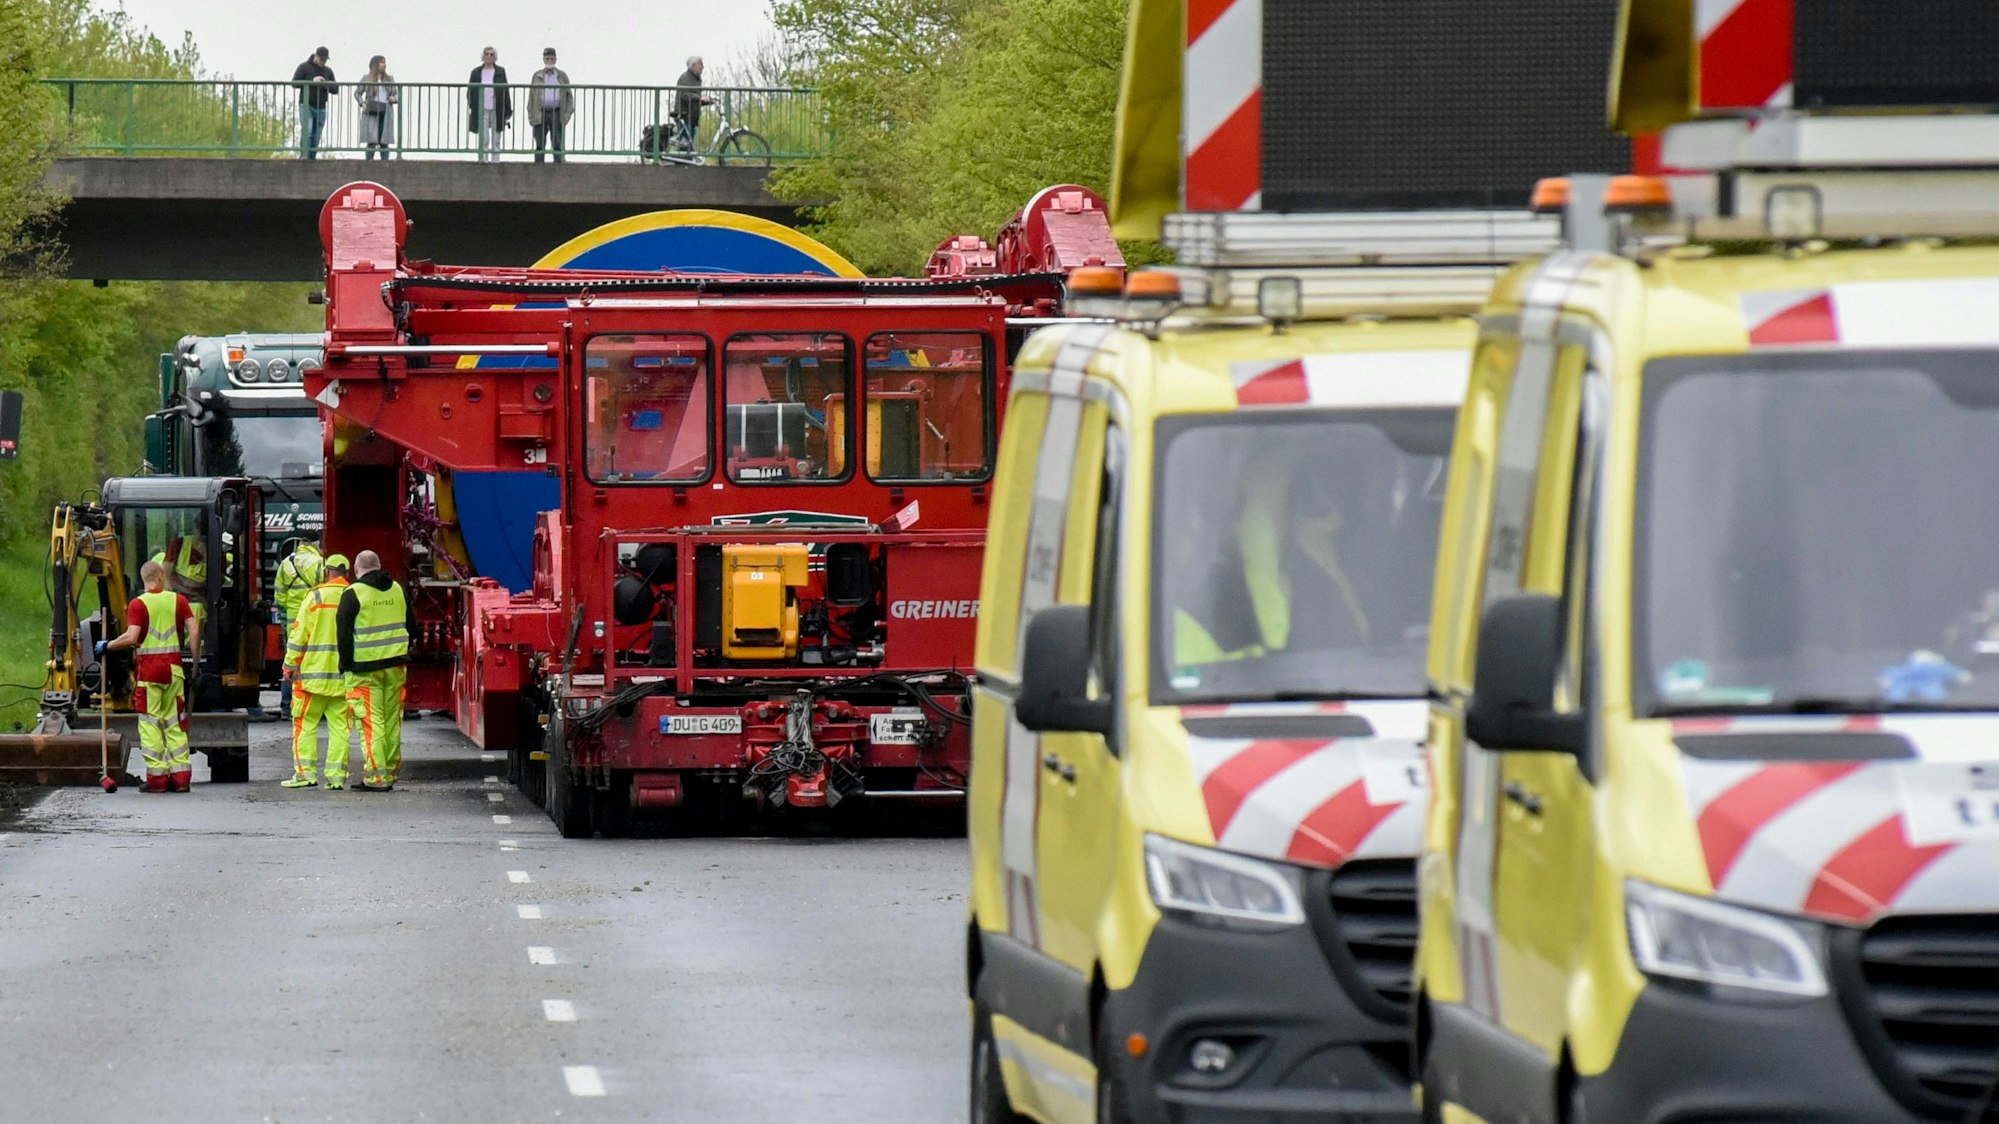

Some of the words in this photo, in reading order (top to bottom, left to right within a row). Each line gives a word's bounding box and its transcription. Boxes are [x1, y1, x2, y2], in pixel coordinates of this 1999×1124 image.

[890, 600, 981, 620] GREINER
[673, 718, 691, 731] DU
[699, 718, 708, 731] G
[711, 718, 736, 731] 409
